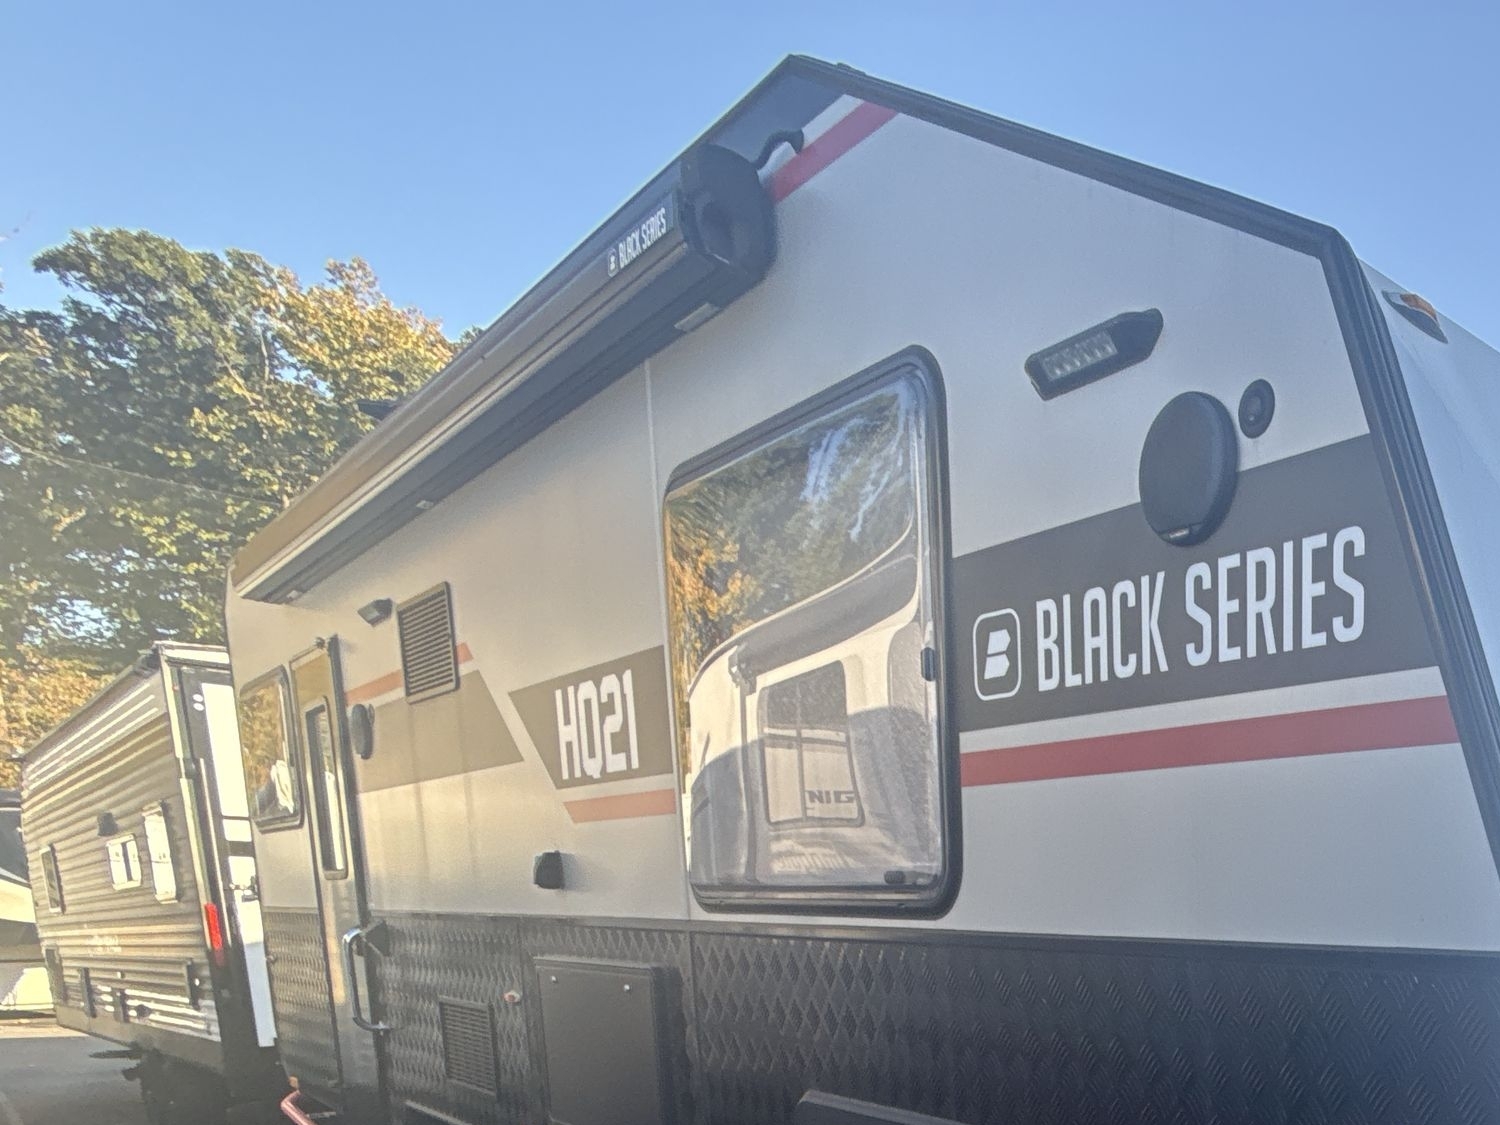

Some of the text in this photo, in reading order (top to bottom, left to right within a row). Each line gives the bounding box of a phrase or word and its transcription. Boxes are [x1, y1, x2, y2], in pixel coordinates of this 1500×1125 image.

[618, 207, 667, 269] BLACK SERIES
[1035, 571, 1169, 692] BLACK
[1185, 525, 1366, 667] SERIES
[554, 668, 640, 780] HQ21
